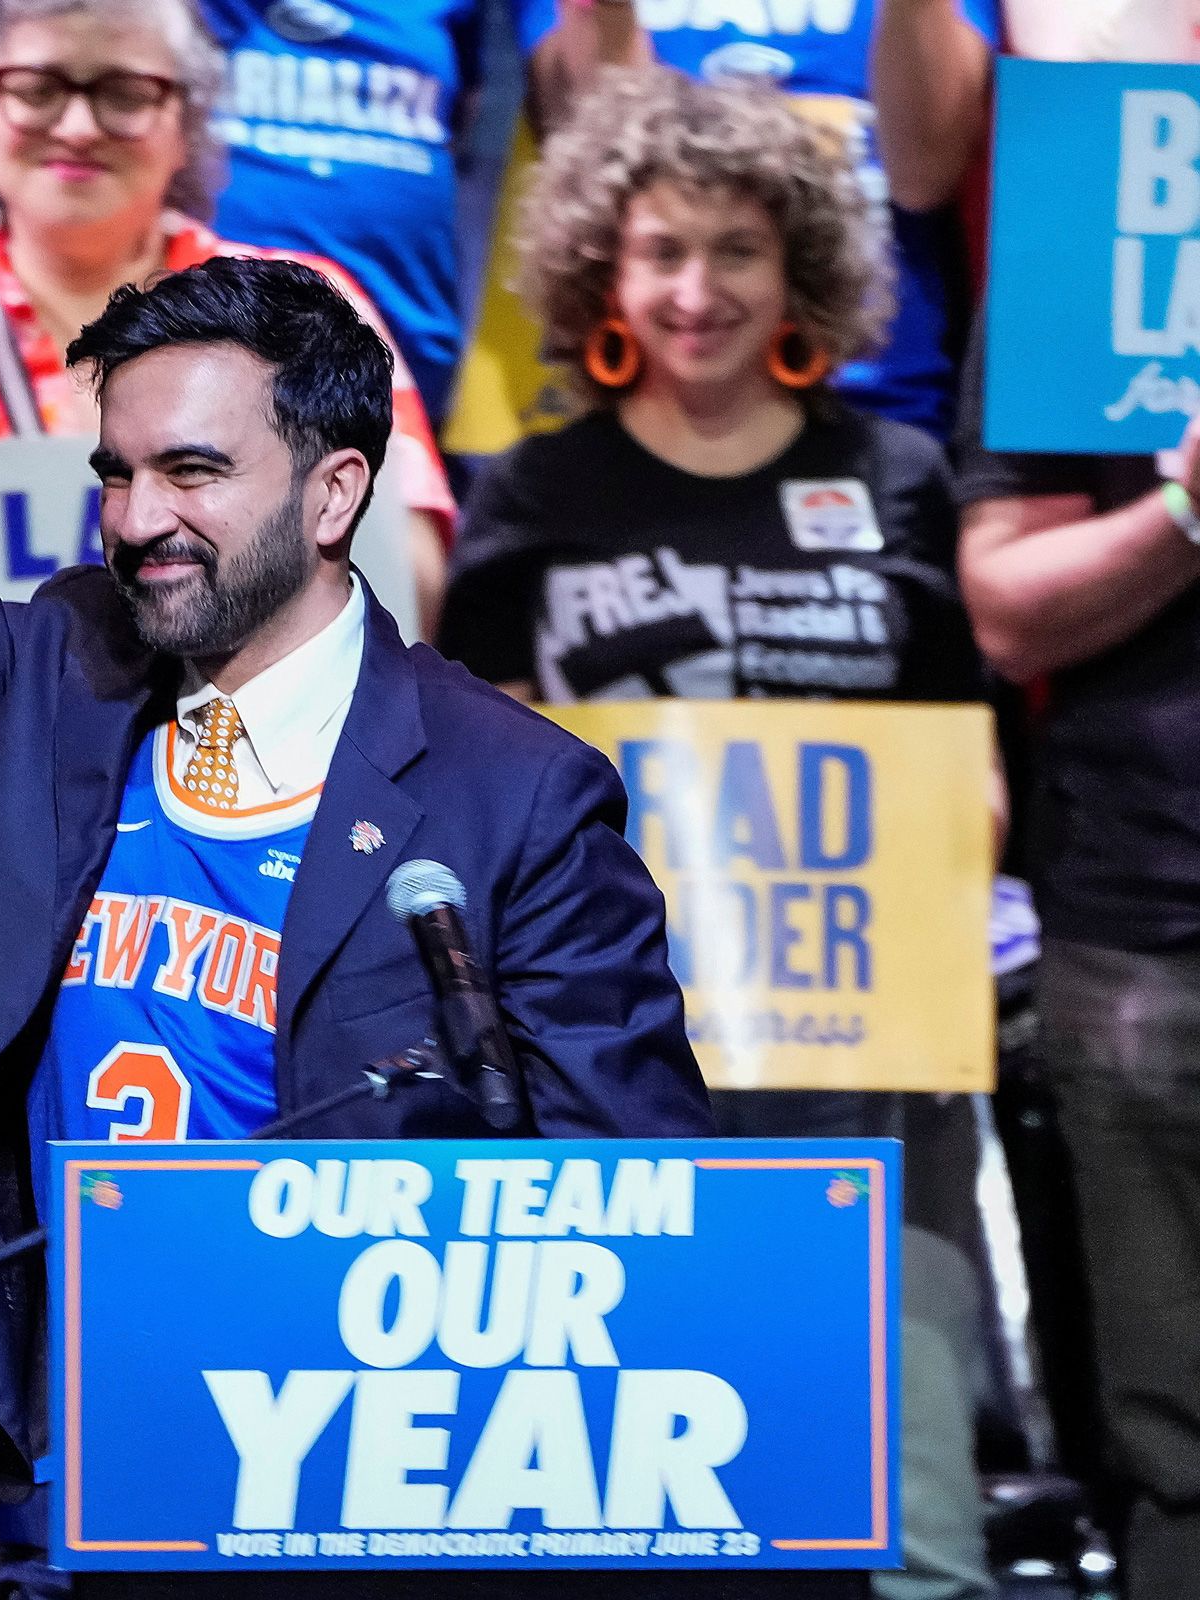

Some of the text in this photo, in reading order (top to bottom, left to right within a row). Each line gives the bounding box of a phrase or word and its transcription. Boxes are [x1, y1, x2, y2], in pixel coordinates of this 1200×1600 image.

[248, 1157, 696, 1239] OUR TEAM
[337, 1238, 627, 1369] OUR
[201, 1368, 750, 1530] YEAR
[215, 1531, 283, 1558] VOTE
[282, 1531, 317, 1558] IN
[316, 1531, 368, 1558] THE
[366, 1531, 531, 1558] DEMOCRATIC
[529, 1531, 653, 1558] PRIMARY
[650, 1531, 720, 1558] JUNE
